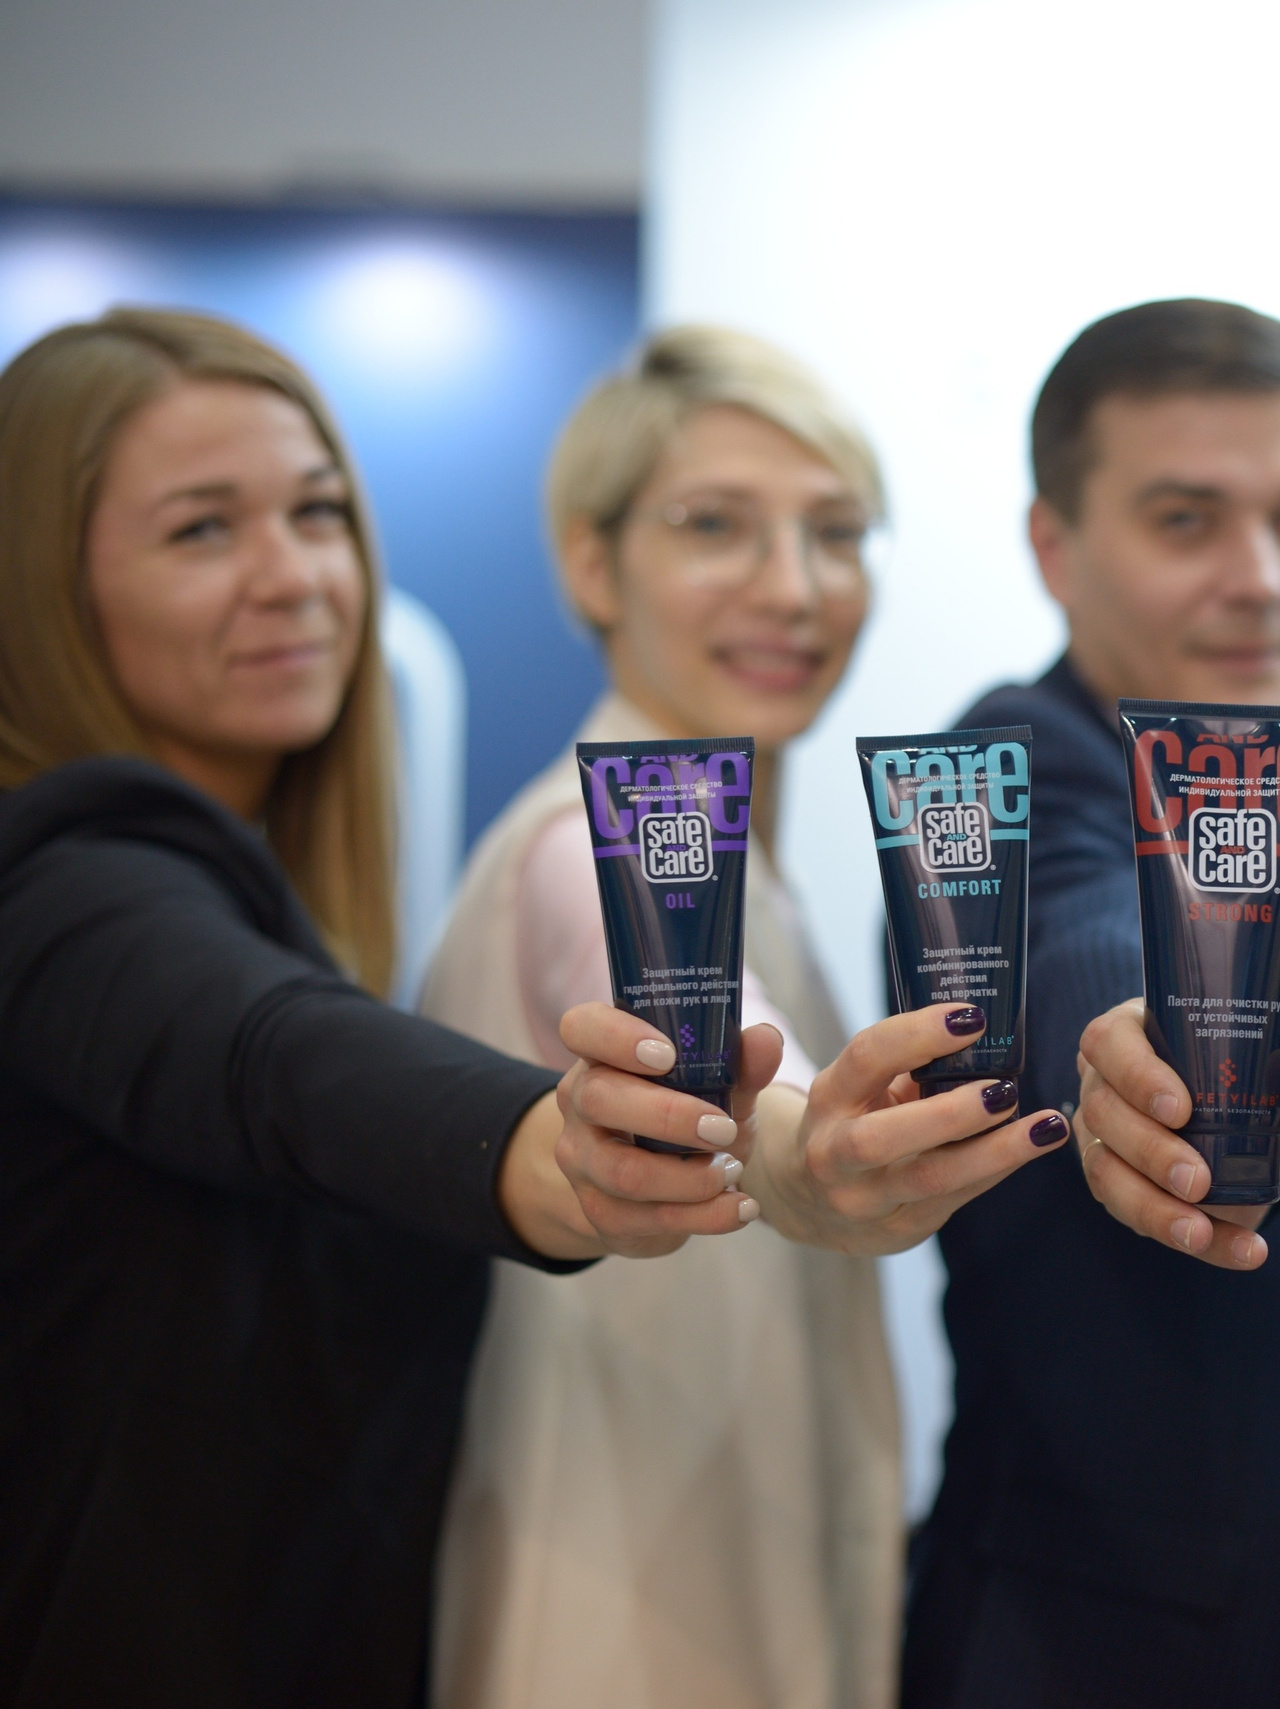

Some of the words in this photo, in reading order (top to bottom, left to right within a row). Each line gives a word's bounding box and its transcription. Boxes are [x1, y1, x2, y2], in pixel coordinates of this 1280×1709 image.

[898, 774, 968, 784] ДЕРМАТОЛОГИЧЕСКОЕ
[968, 772, 1000, 780] СРЕДСТВО
[1169, 773, 1254, 786] ДЕРМАТОЛОГИЧЕСКОЕ
[620, 784, 689, 793] ДЕРМАТОЛОГИЧЕСКОЕ
[690, 781, 723, 789] СРЕДСТВО
[967, 782, 994, 790] ЗАЩИТЫ
[1178, 786, 1251, 797] ИНДИВИДУАЛЬНОЙ
[947, 833, 967, 841] AND
[1219, 846, 1247, 854] AND
[917, 879, 1002, 899] COMFORT
[666, 892, 696, 909] OIL
[1188, 902, 1273, 923] STRONG
[923, 945, 975, 958] Защитный
[977, 946, 1002, 957] крем
[643, 965, 696, 979] Защитный
[698, 966, 723, 977] крем
[917, 960, 1009, 973] комбинированного
[940, 974, 987, 987] действия
[623, 982, 699, 995] гидрофильного
[931, 991, 950, 1000] под
[952, 988, 998, 999] перчатки
[633, 999, 651, 1009] для
[653, 997, 680, 1006] кожи
[683, 996, 701, 1007] рук
[710, 994, 731, 1003] лица
[1167, 995, 1200, 1006] Паста
[1202, 998, 1223, 1009] для
[1226, 999, 1269, 1009] очистки
[1188, 1013, 1201, 1022] от
[1203, 1012, 1268, 1024] устойчивых
[1195, 1028, 1263, 1040] загрязнений
